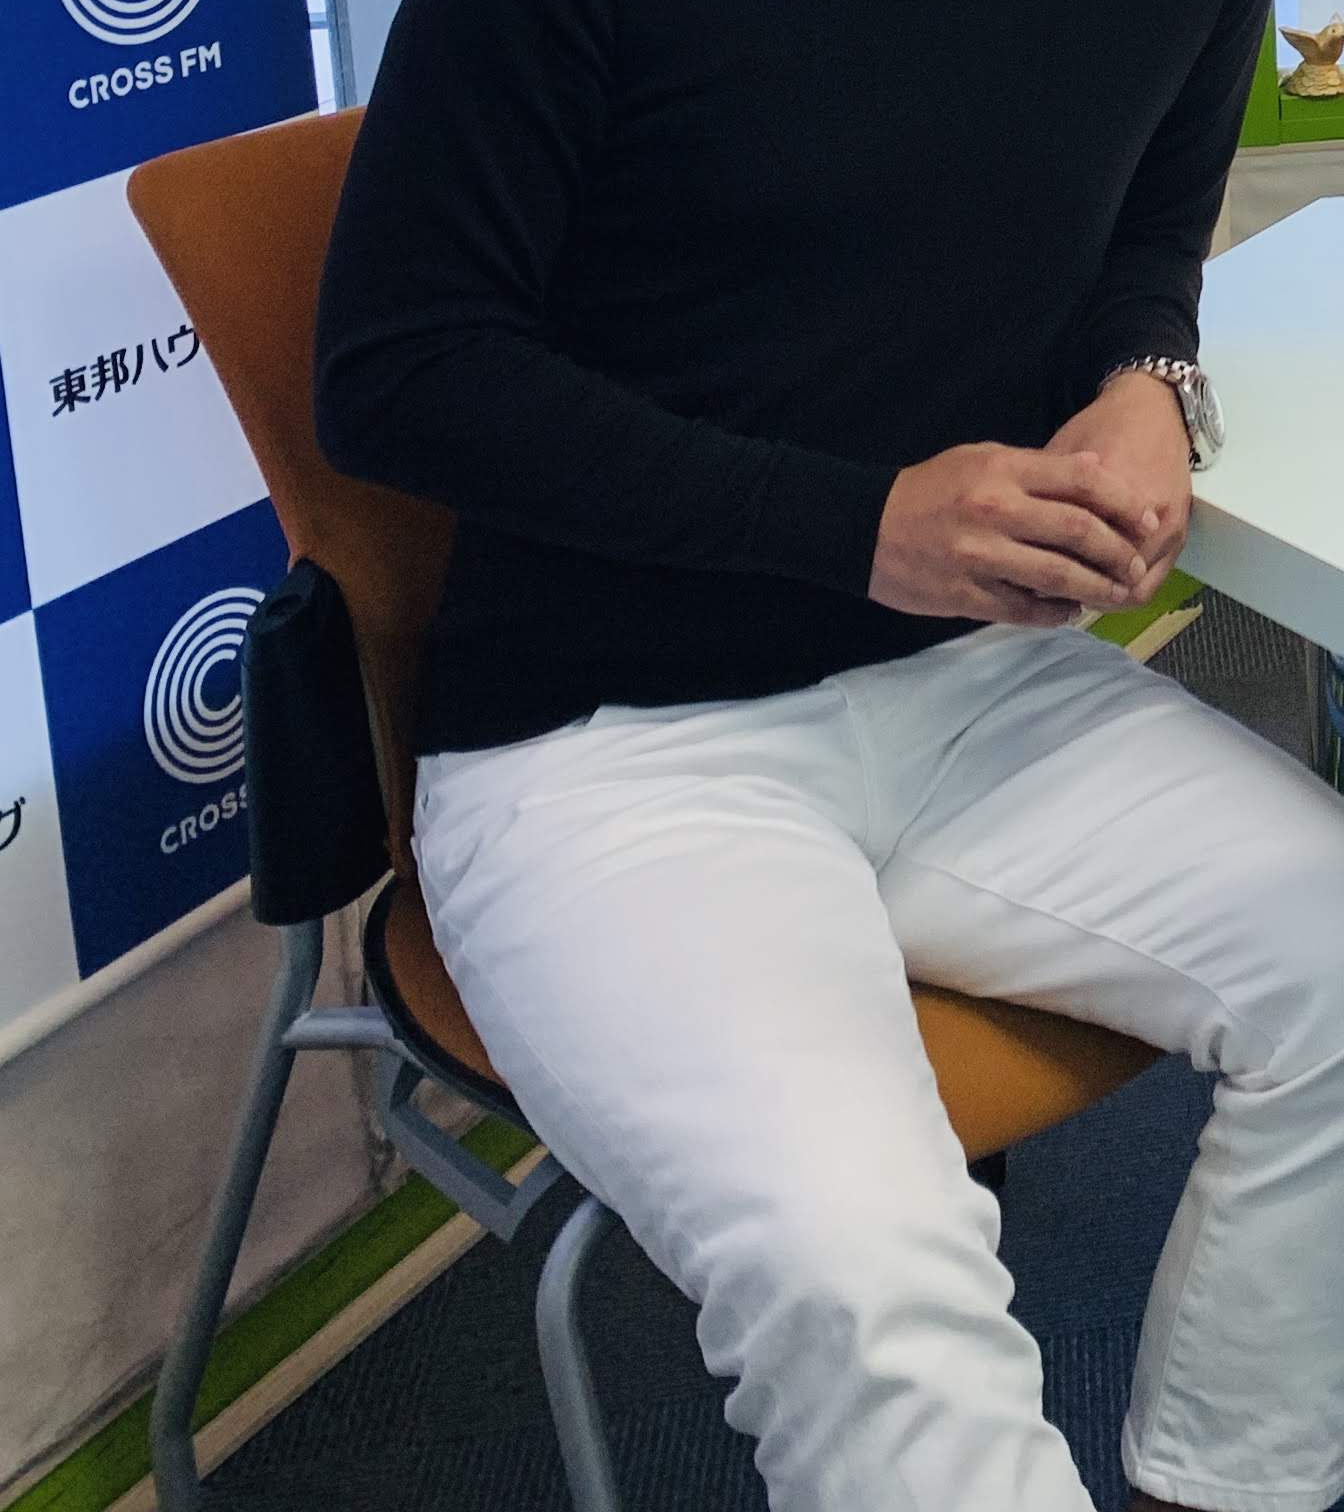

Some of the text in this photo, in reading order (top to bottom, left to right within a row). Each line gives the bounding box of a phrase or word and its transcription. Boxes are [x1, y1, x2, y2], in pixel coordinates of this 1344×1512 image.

[69, 41, 222, 109] CROSS FM
[49, 324, 200, 417] 東邦ハウ
